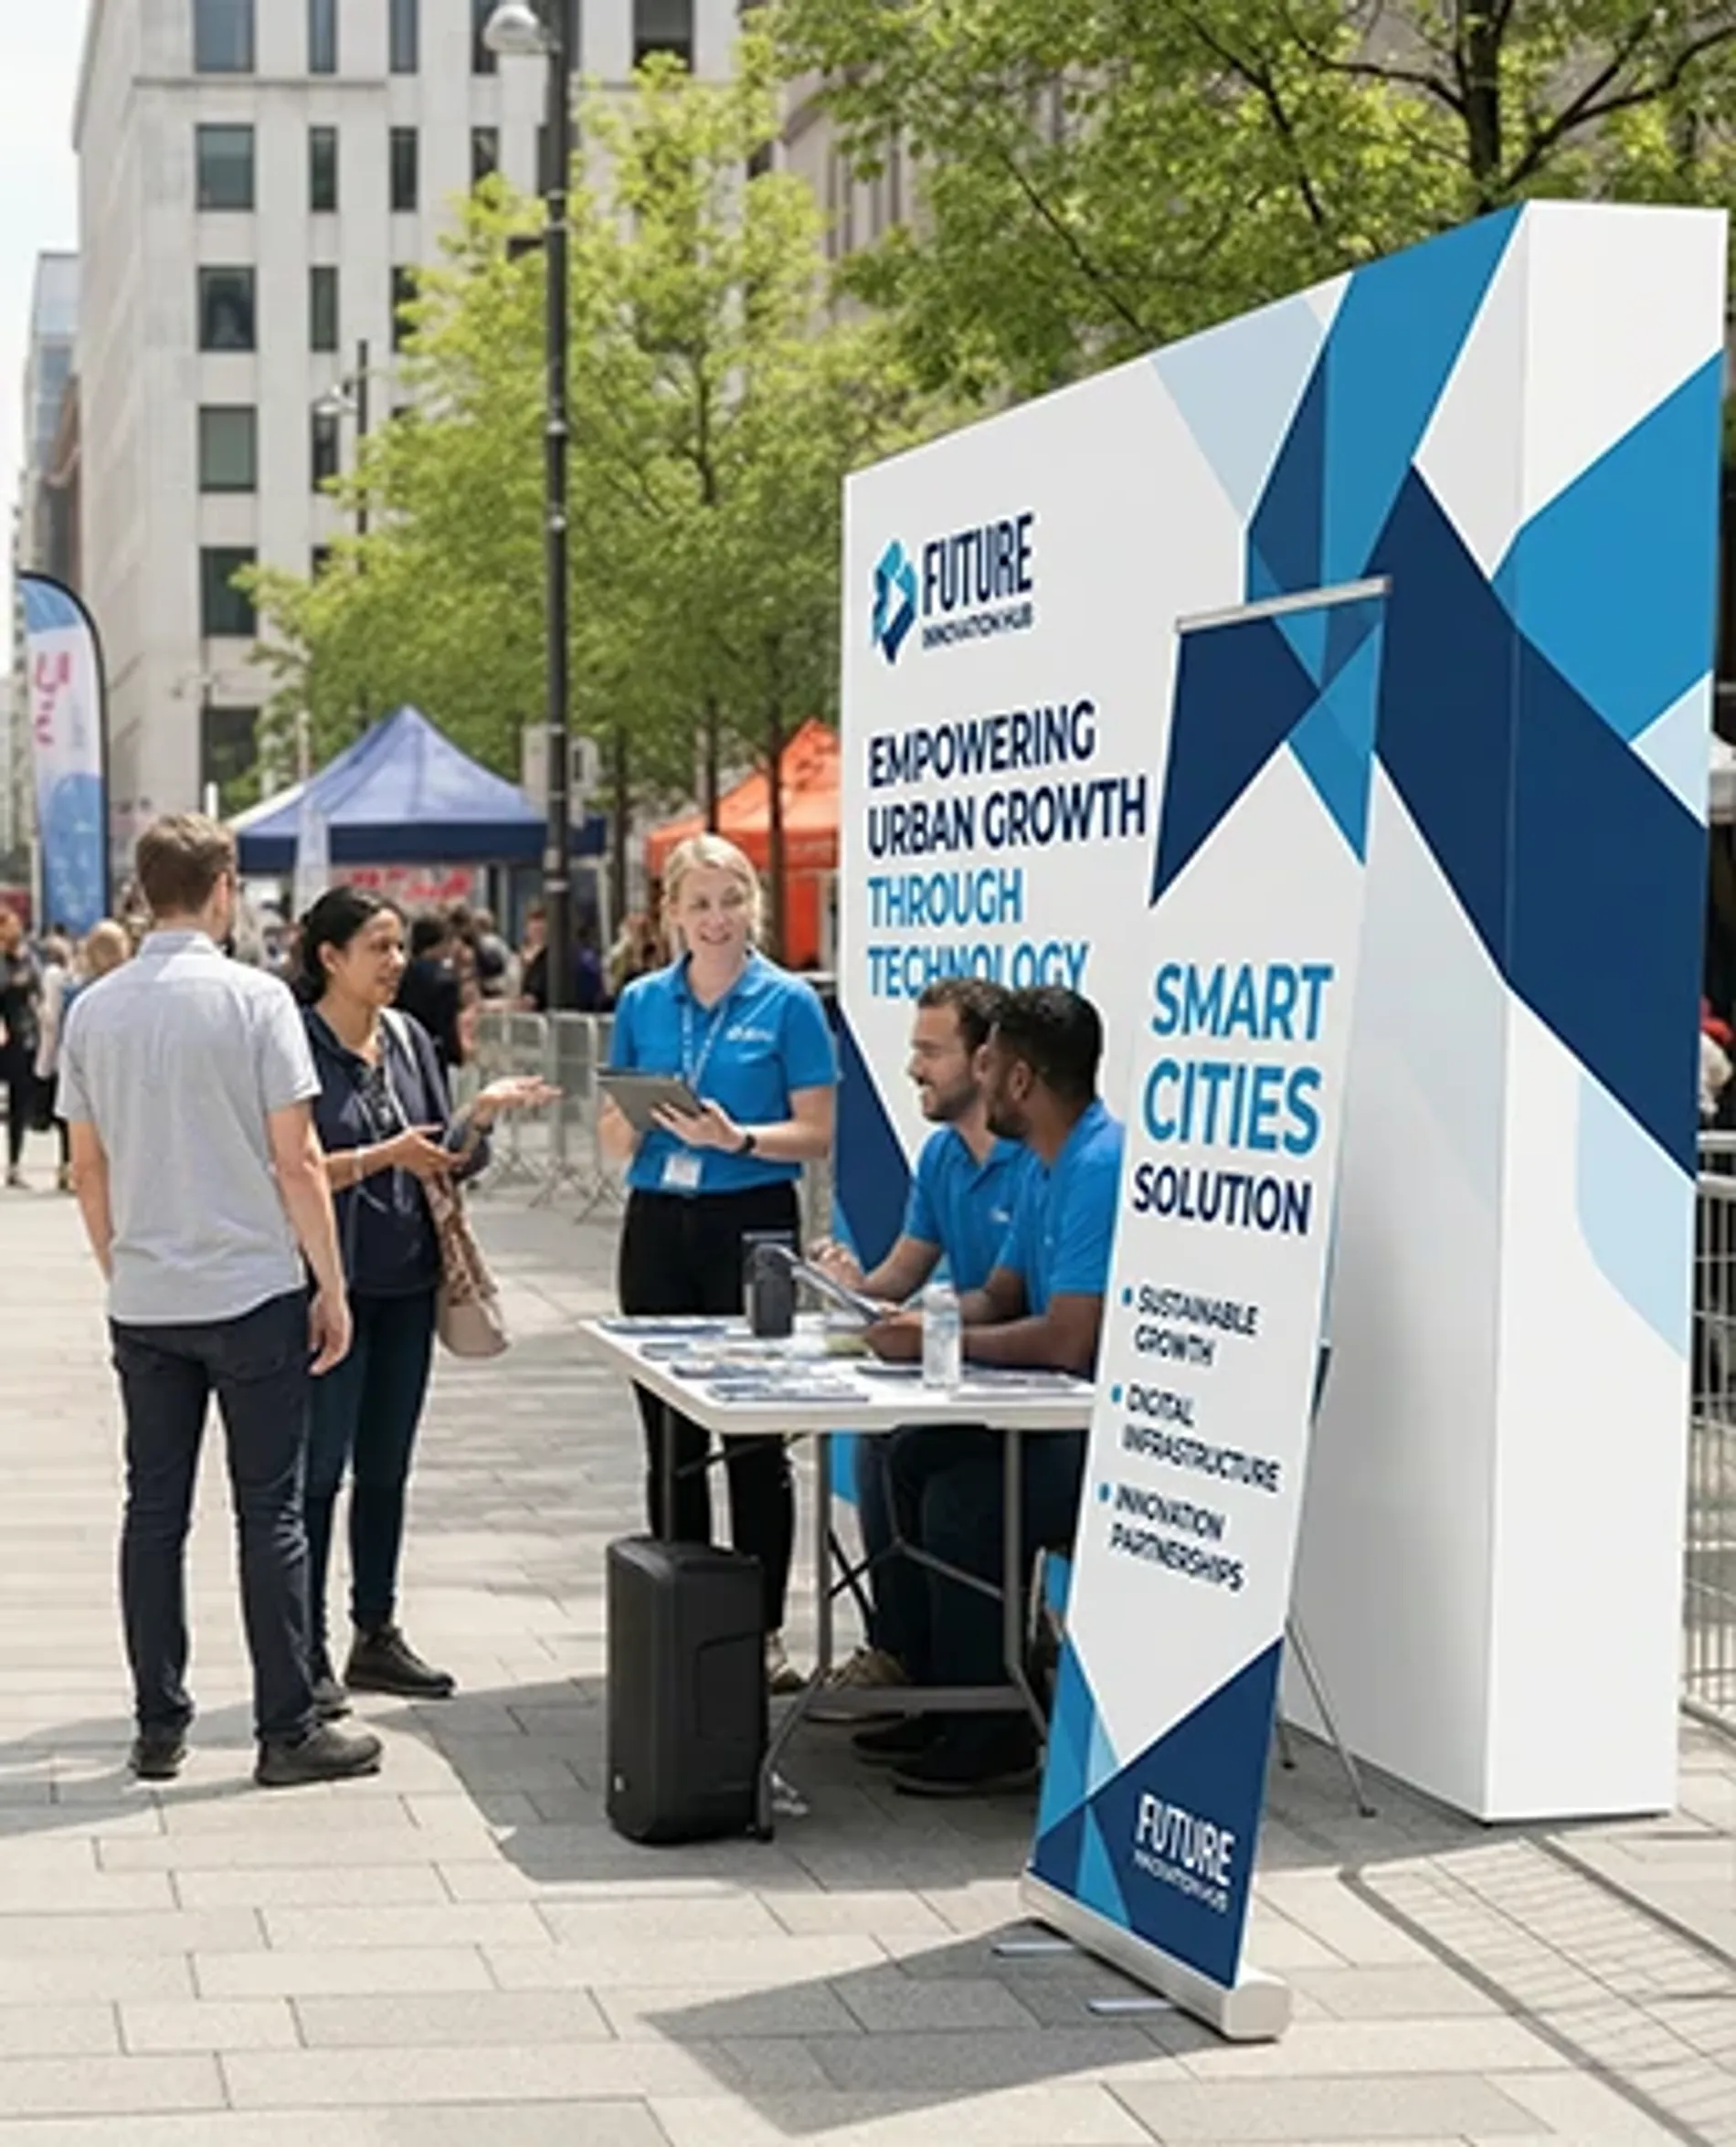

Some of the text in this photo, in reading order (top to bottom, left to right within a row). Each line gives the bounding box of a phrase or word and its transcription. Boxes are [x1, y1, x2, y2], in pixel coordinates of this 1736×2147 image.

[922, 512, 1033, 616] FUTURE
[869, 701, 1096, 788] EMPOWERING
[868, 776, 1148, 858] URBAN GROWTH
[867, 869, 1022, 927] THROUGH
[1151, 963, 1334, 1041] SMART
[1143, 1058, 1322, 1155] CITIES
[1133, 1162, 1312, 1235] SOLUTION
[1134, 1324, 1215, 1366] GROWTH
[1138, 1284, 1258, 1337] SUSTAINABLE
[1126, 1383, 1193, 1427] DIGITAL
[1122, 1424, 1281, 1493] INFRASTRUCTURE
[1116, 1483, 1226, 1541] INNOVATION
[1110, 1522, 1244, 1592] PARTNERSHIPS
[1136, 1793, 1236, 1888] FUTURE
